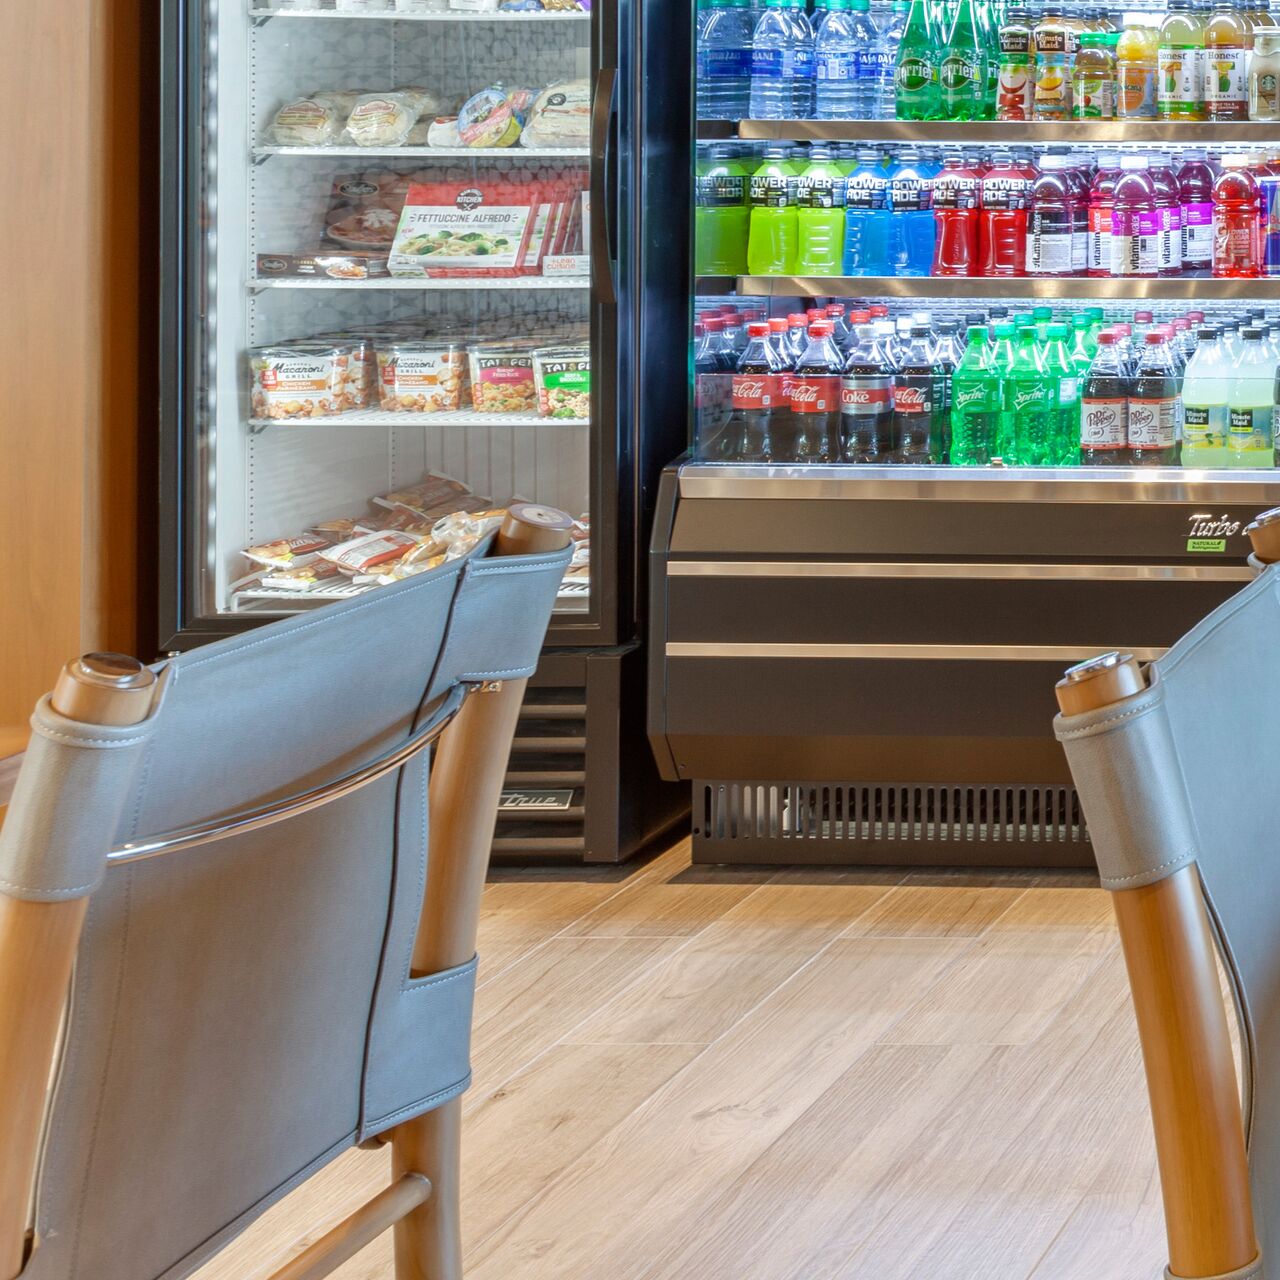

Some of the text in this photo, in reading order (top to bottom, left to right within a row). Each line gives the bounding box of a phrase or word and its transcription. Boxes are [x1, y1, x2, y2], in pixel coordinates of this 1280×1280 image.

[1000, 35, 1026, 43] Minute
[1036, 34, 1063, 43] Minute
[1003, 41, 1023, 50] Maid
[1039, 41, 1060, 50] Maid
[1208, 51, 1239, 60] Honest
[941, 61, 976, 81] errier
[751, 176, 786, 188] OWER
[797, 176, 832, 188] OWER
[849, 177, 889, 189] POWER
[933, 179, 974, 190] POWER
[983, 178, 1025, 190] POWER
[456, 195, 484, 203] KITCHEN
[893, 191, 919, 202] ADE
[933, 190, 956, 200] ADE
[983, 190, 1008, 201] ADE
[417, 213, 512, 223] FETTUCCINE ALFREDO
[272, 362, 325, 373] Macaroni
[388, 357, 435, 369] Macaroni
[479, 358, 532, 368] TAI PEI
[546, 363, 566, 373] TAI
[842, 389, 869, 403] Coke
[957, 389, 985, 402] Sprite
[1016, 389, 1044, 402] Sprite
[1087, 409, 1114, 427] Dr Pepper
[1189, 514, 1241, 537] Turbo
